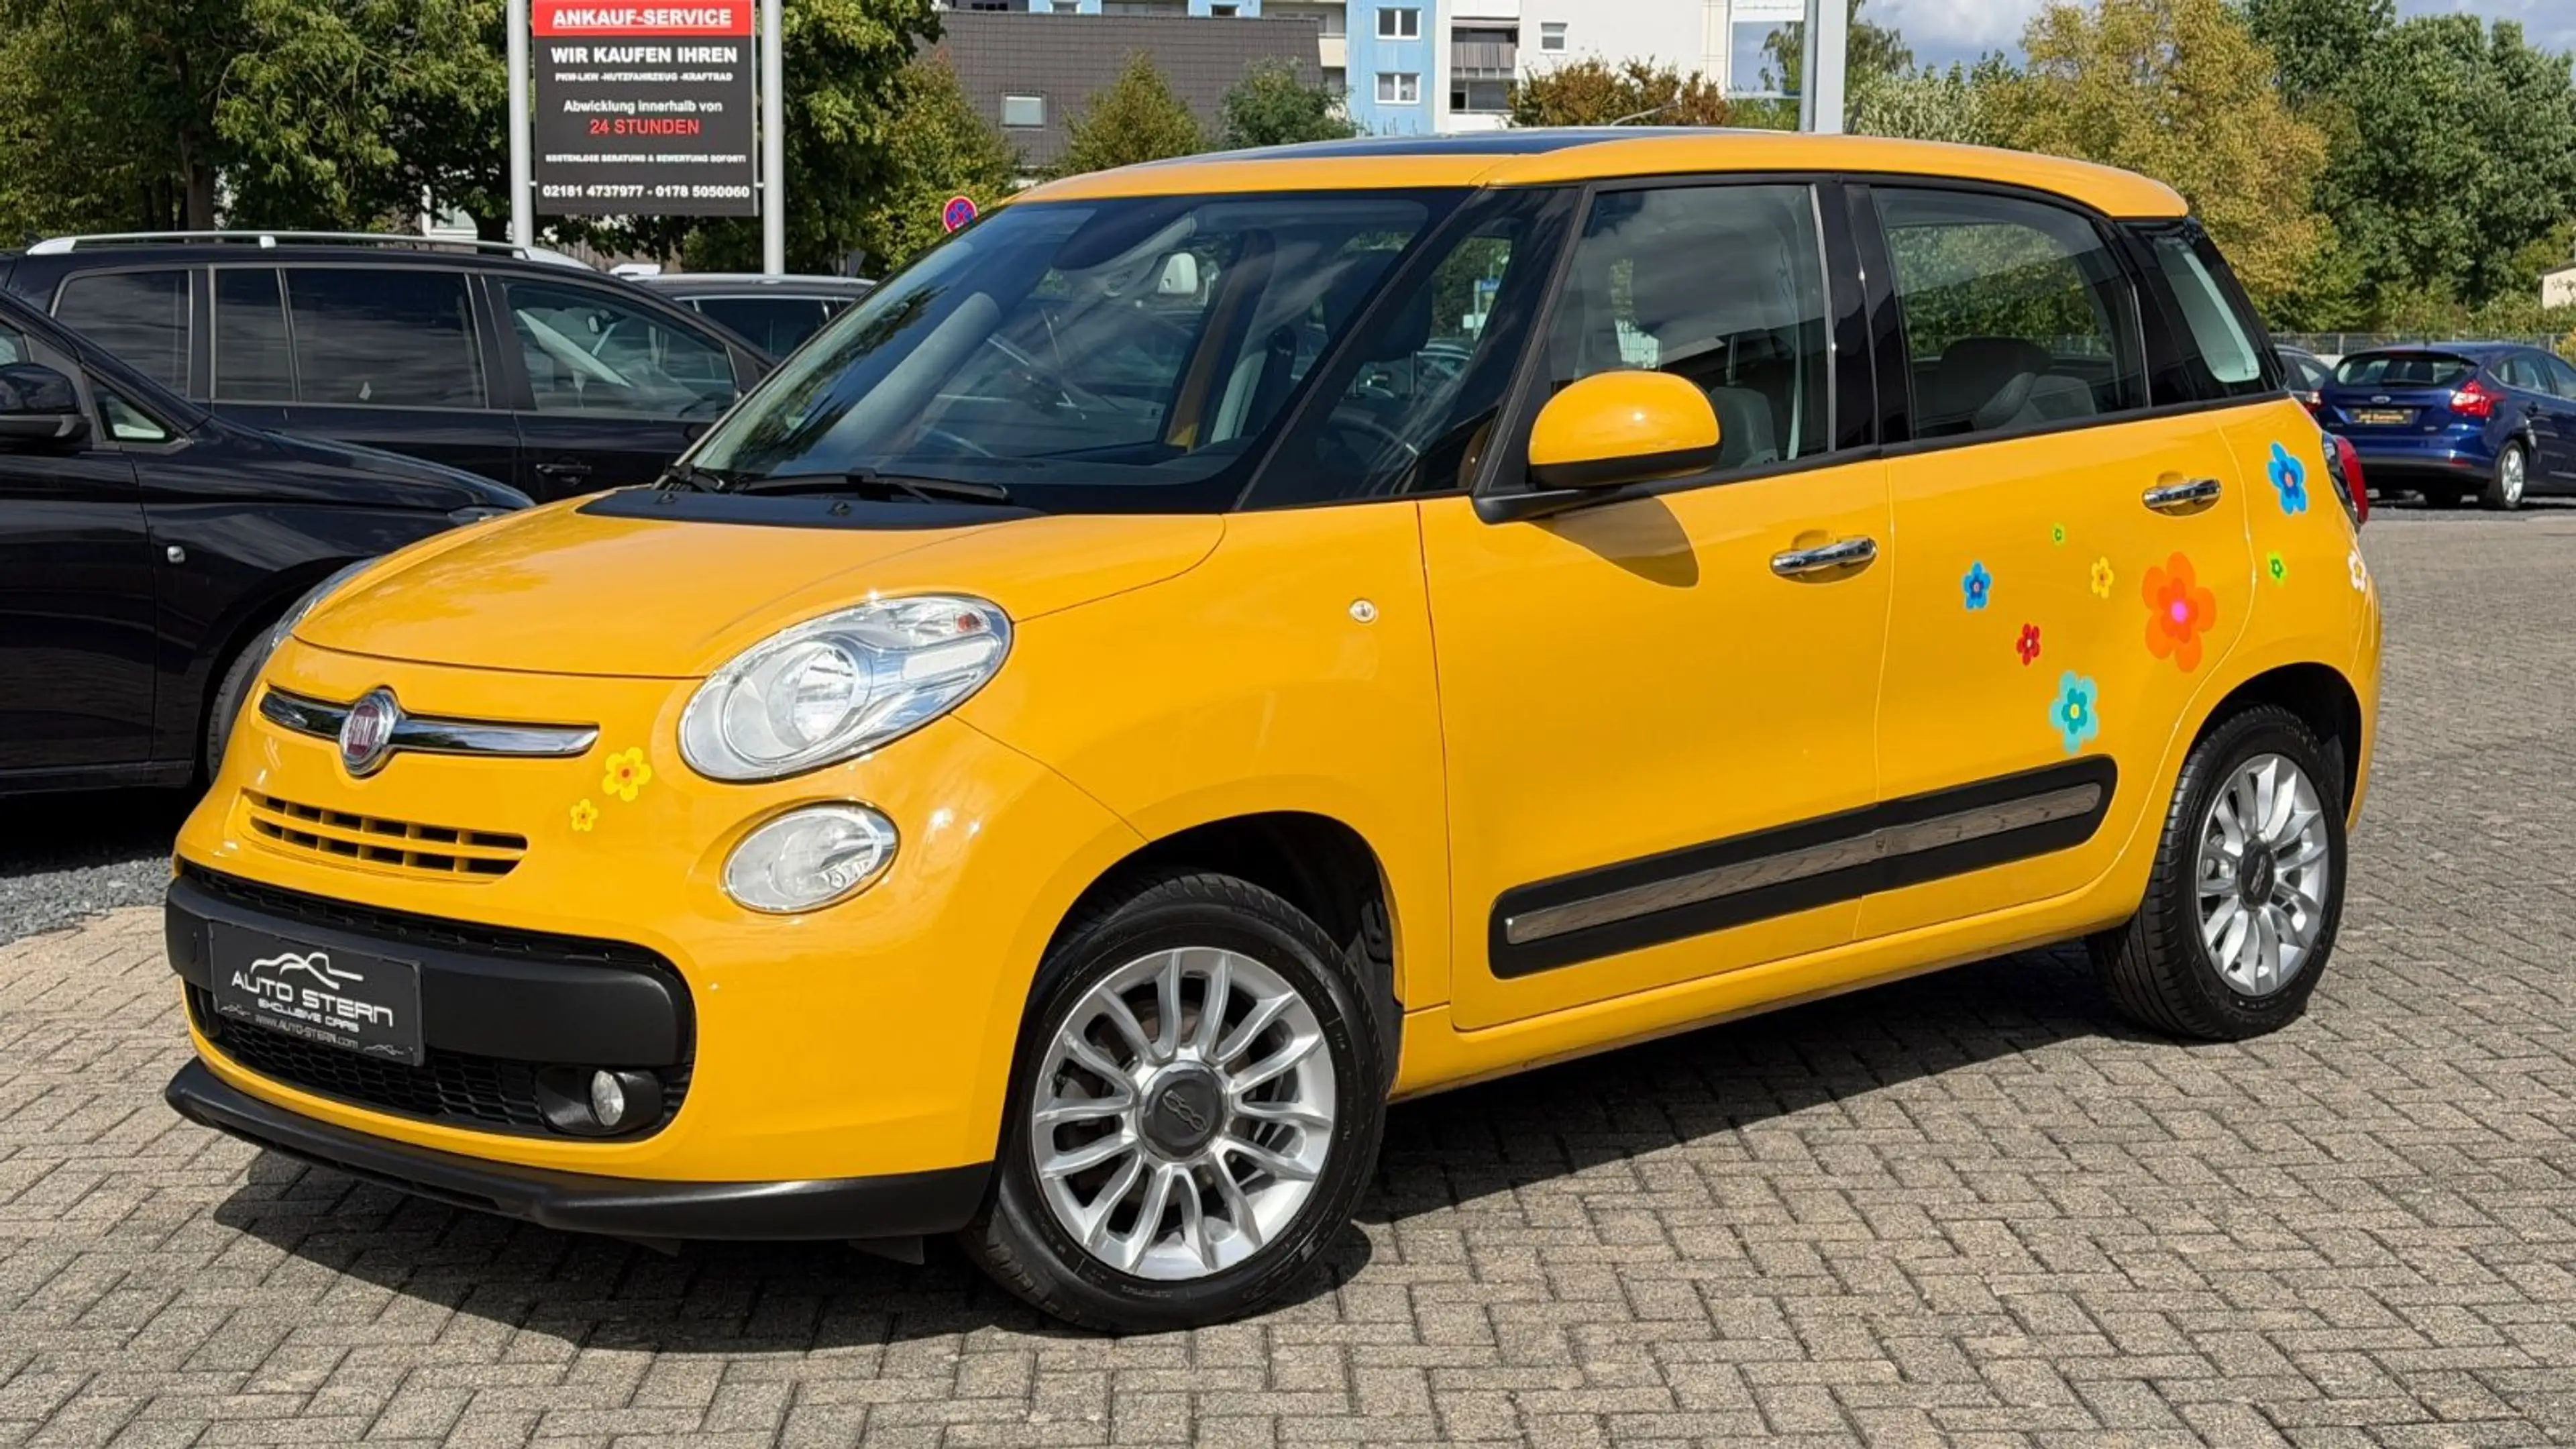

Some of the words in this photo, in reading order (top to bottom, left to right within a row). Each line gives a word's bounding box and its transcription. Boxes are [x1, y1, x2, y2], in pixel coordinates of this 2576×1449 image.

[552, 9, 732, 27] ANKAUF-SERVICE
[551, 47, 588, 63] WIR
[594, 47, 672, 63] KAUFEN
[678, 47, 737, 63] IHREN
[555, 72, 599, 82] PKW-LKW
[564, 100, 635, 115] Abwicklung
[638, 100, 696, 112] innerhalb
[699, 102, 722, 112] von
[590, 119, 610, 134] 24
[614, 119, 700, 134] STUNDEN
[545, 154, 599, 163] KOSTENLOSE
[601, 154, 646, 163] BERATUNG
[647, 154, 655, 163] &
[656, 154, 708, 163] BEWERTUNG
[710, 154, 747, 163] SOFORT!
[543, 185, 582, 197] 02181
[586, 185, 644, 197] 4737977
[655, 185, 689, 197] 0178
[692, 185, 750, 198] 5050060
[231, 971, 293, 1002] AUTO
[301, 987, 394, 1028] STERN
[258, 998, 322, 1024] EXCLUSIVE
[325, 1015, 360, 1033] CARS
